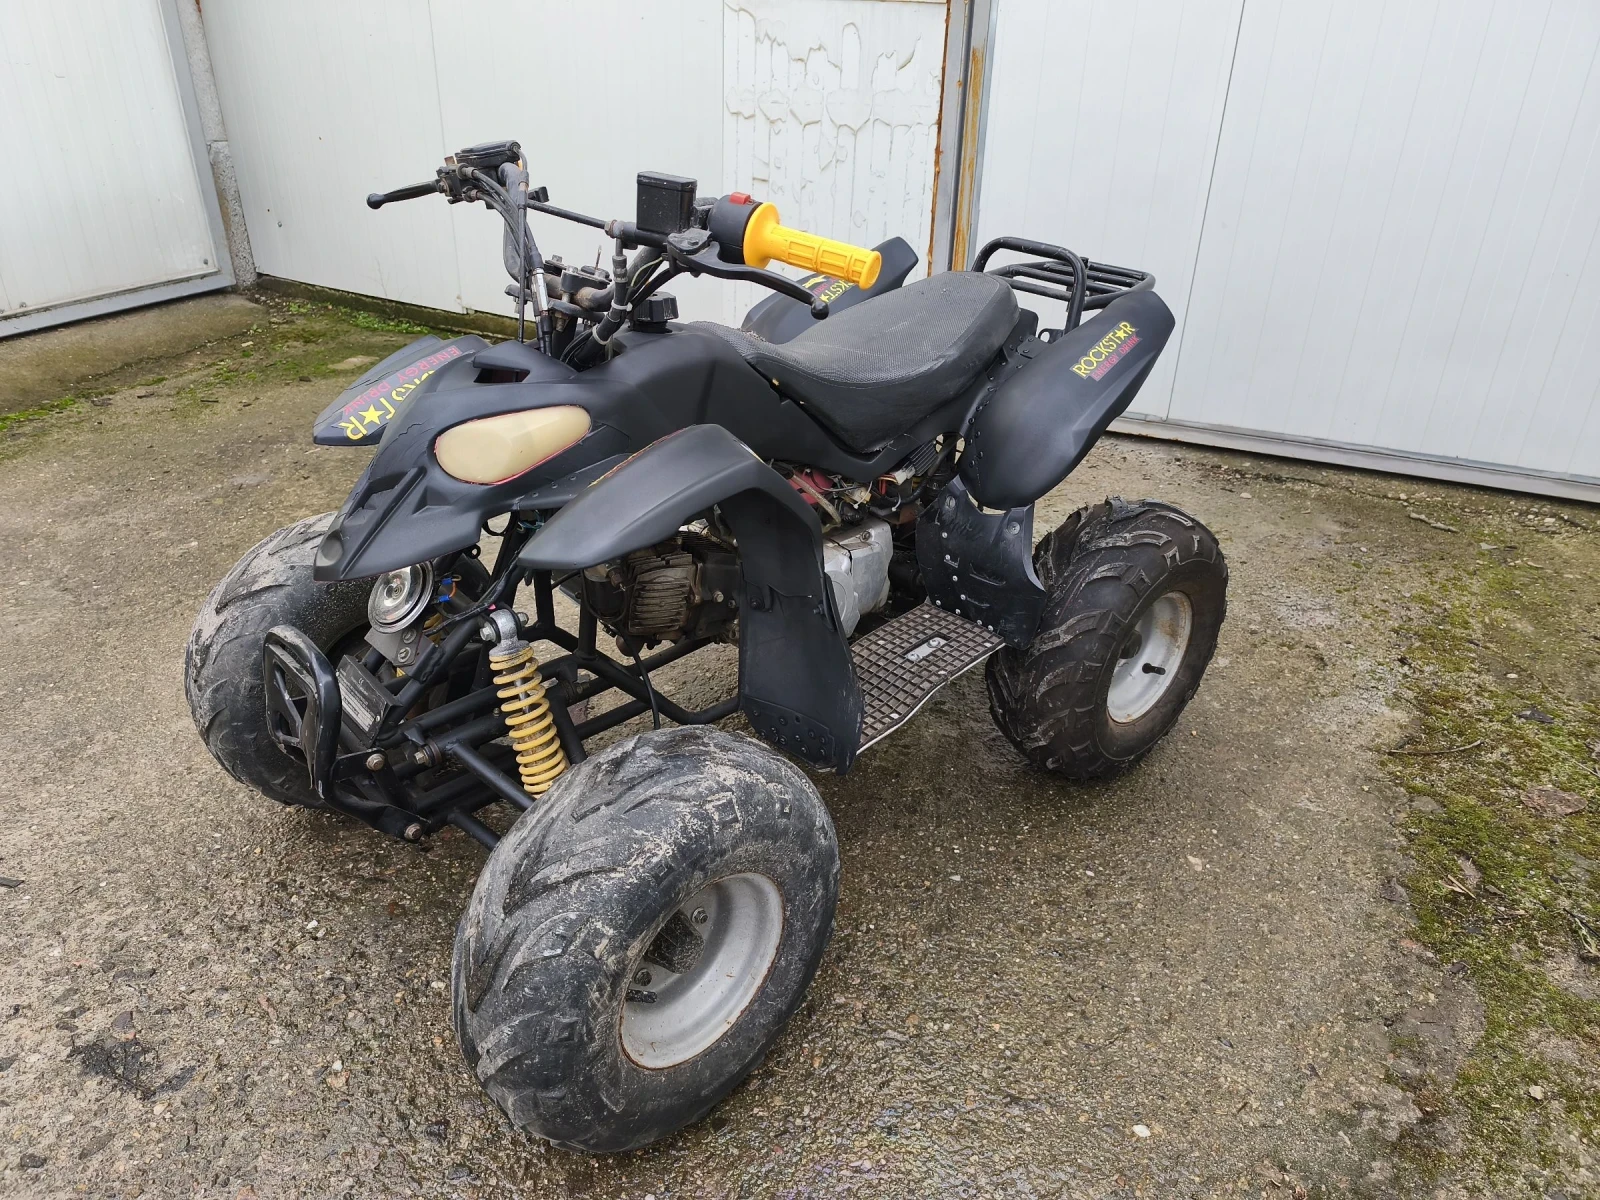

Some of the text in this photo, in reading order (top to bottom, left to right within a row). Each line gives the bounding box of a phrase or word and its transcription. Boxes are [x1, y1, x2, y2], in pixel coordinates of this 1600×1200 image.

[343, 345, 463, 416] ENERGY DRINK
[1091, 334, 1140, 380] ENERGY DRINK
